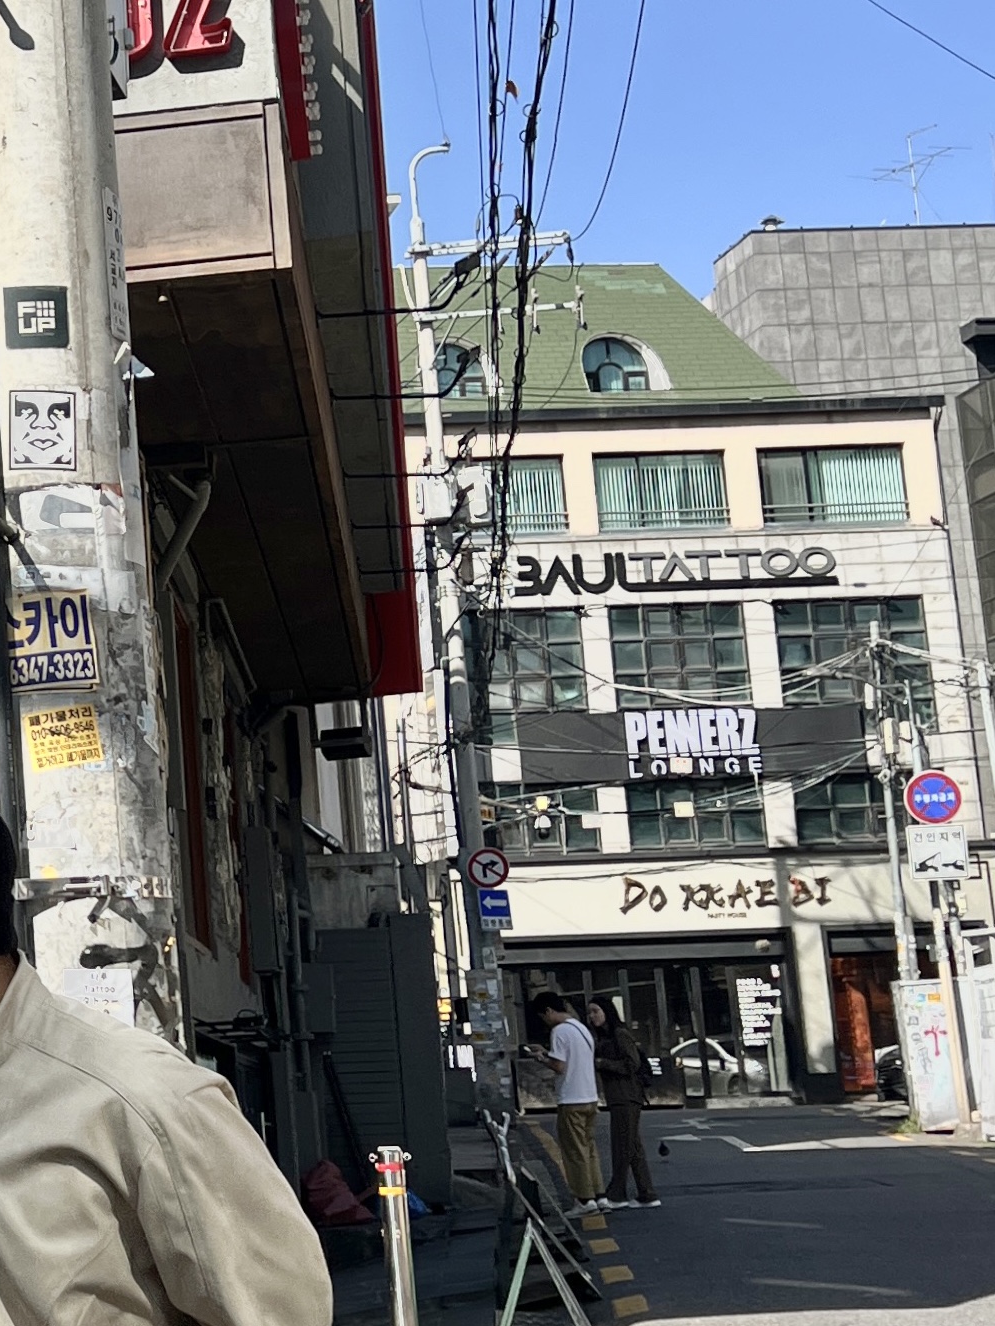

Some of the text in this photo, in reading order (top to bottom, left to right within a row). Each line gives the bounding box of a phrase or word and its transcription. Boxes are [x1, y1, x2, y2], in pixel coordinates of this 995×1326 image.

[18, 317, 56, 334] UP
[624, 708, 761, 759] PENNERZ
[628, 757, 763, 779] LONGE
[914, 831, 961, 843] 견인지역
[84, 985, 116, 993] Tattoo
